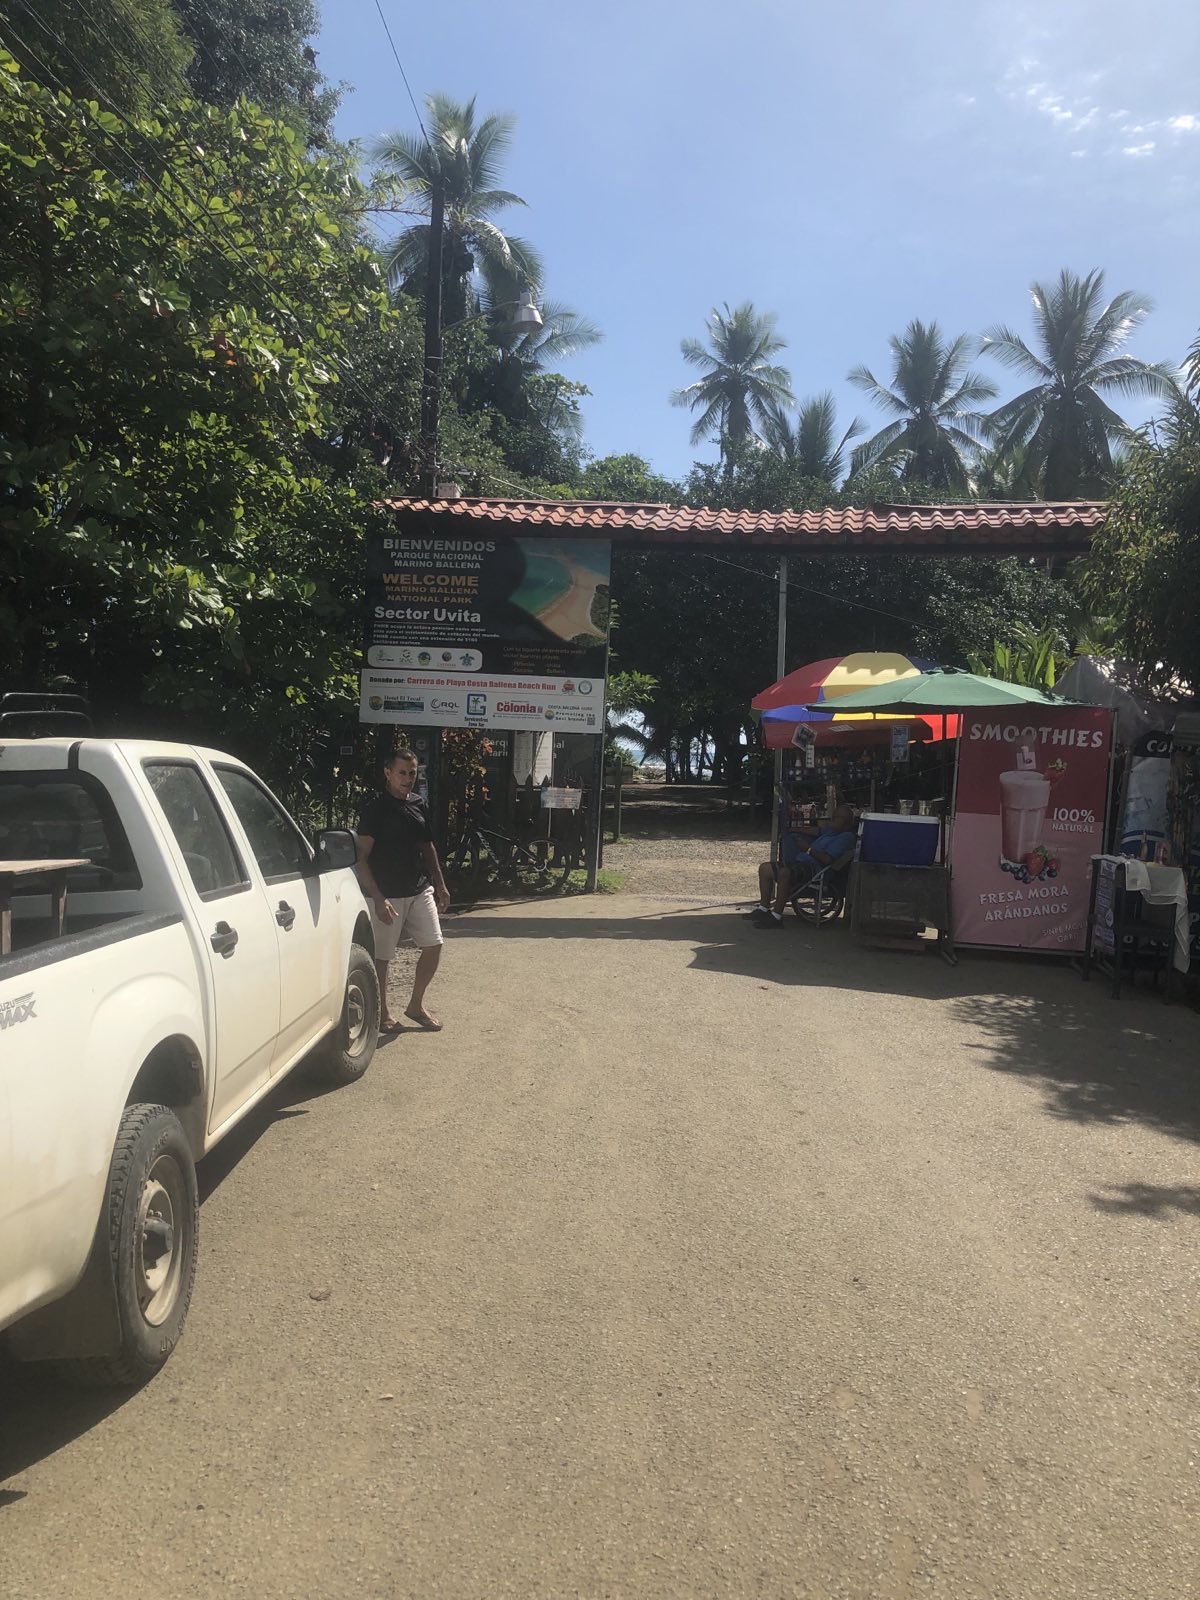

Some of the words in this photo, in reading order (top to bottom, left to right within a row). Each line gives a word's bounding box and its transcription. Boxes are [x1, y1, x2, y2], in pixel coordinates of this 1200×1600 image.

[383, 538, 496, 552] BIENVENIDOS
[390, 551, 430, 559] PARQUE
[394, 560, 432, 568] MARINO
[436, 561, 481, 569] BALLENA
[382, 573, 480, 587] WELCOME
[430, 587, 479, 595] BALLENA
[387, 595, 440, 603] NATIONAL
[443, 596, 472, 604] PARK
[374, 606, 430, 620] Sector
[433, 608, 481, 622] Uvita
[407, 677, 435, 685] Carrera
[446, 679, 465, 687] Playa
[496, 702, 536, 713] Colonia
[969, 723, 1103, 748] SMOOTHIES
[1053, 807, 1095, 823] 100%
[1052, 823, 1095, 833] NATURAL
[979, 889, 1024, 905] FRESA
[1028, 884, 1069, 899] MORA
[984, 903, 1068, 921] ARÁNDANOS
